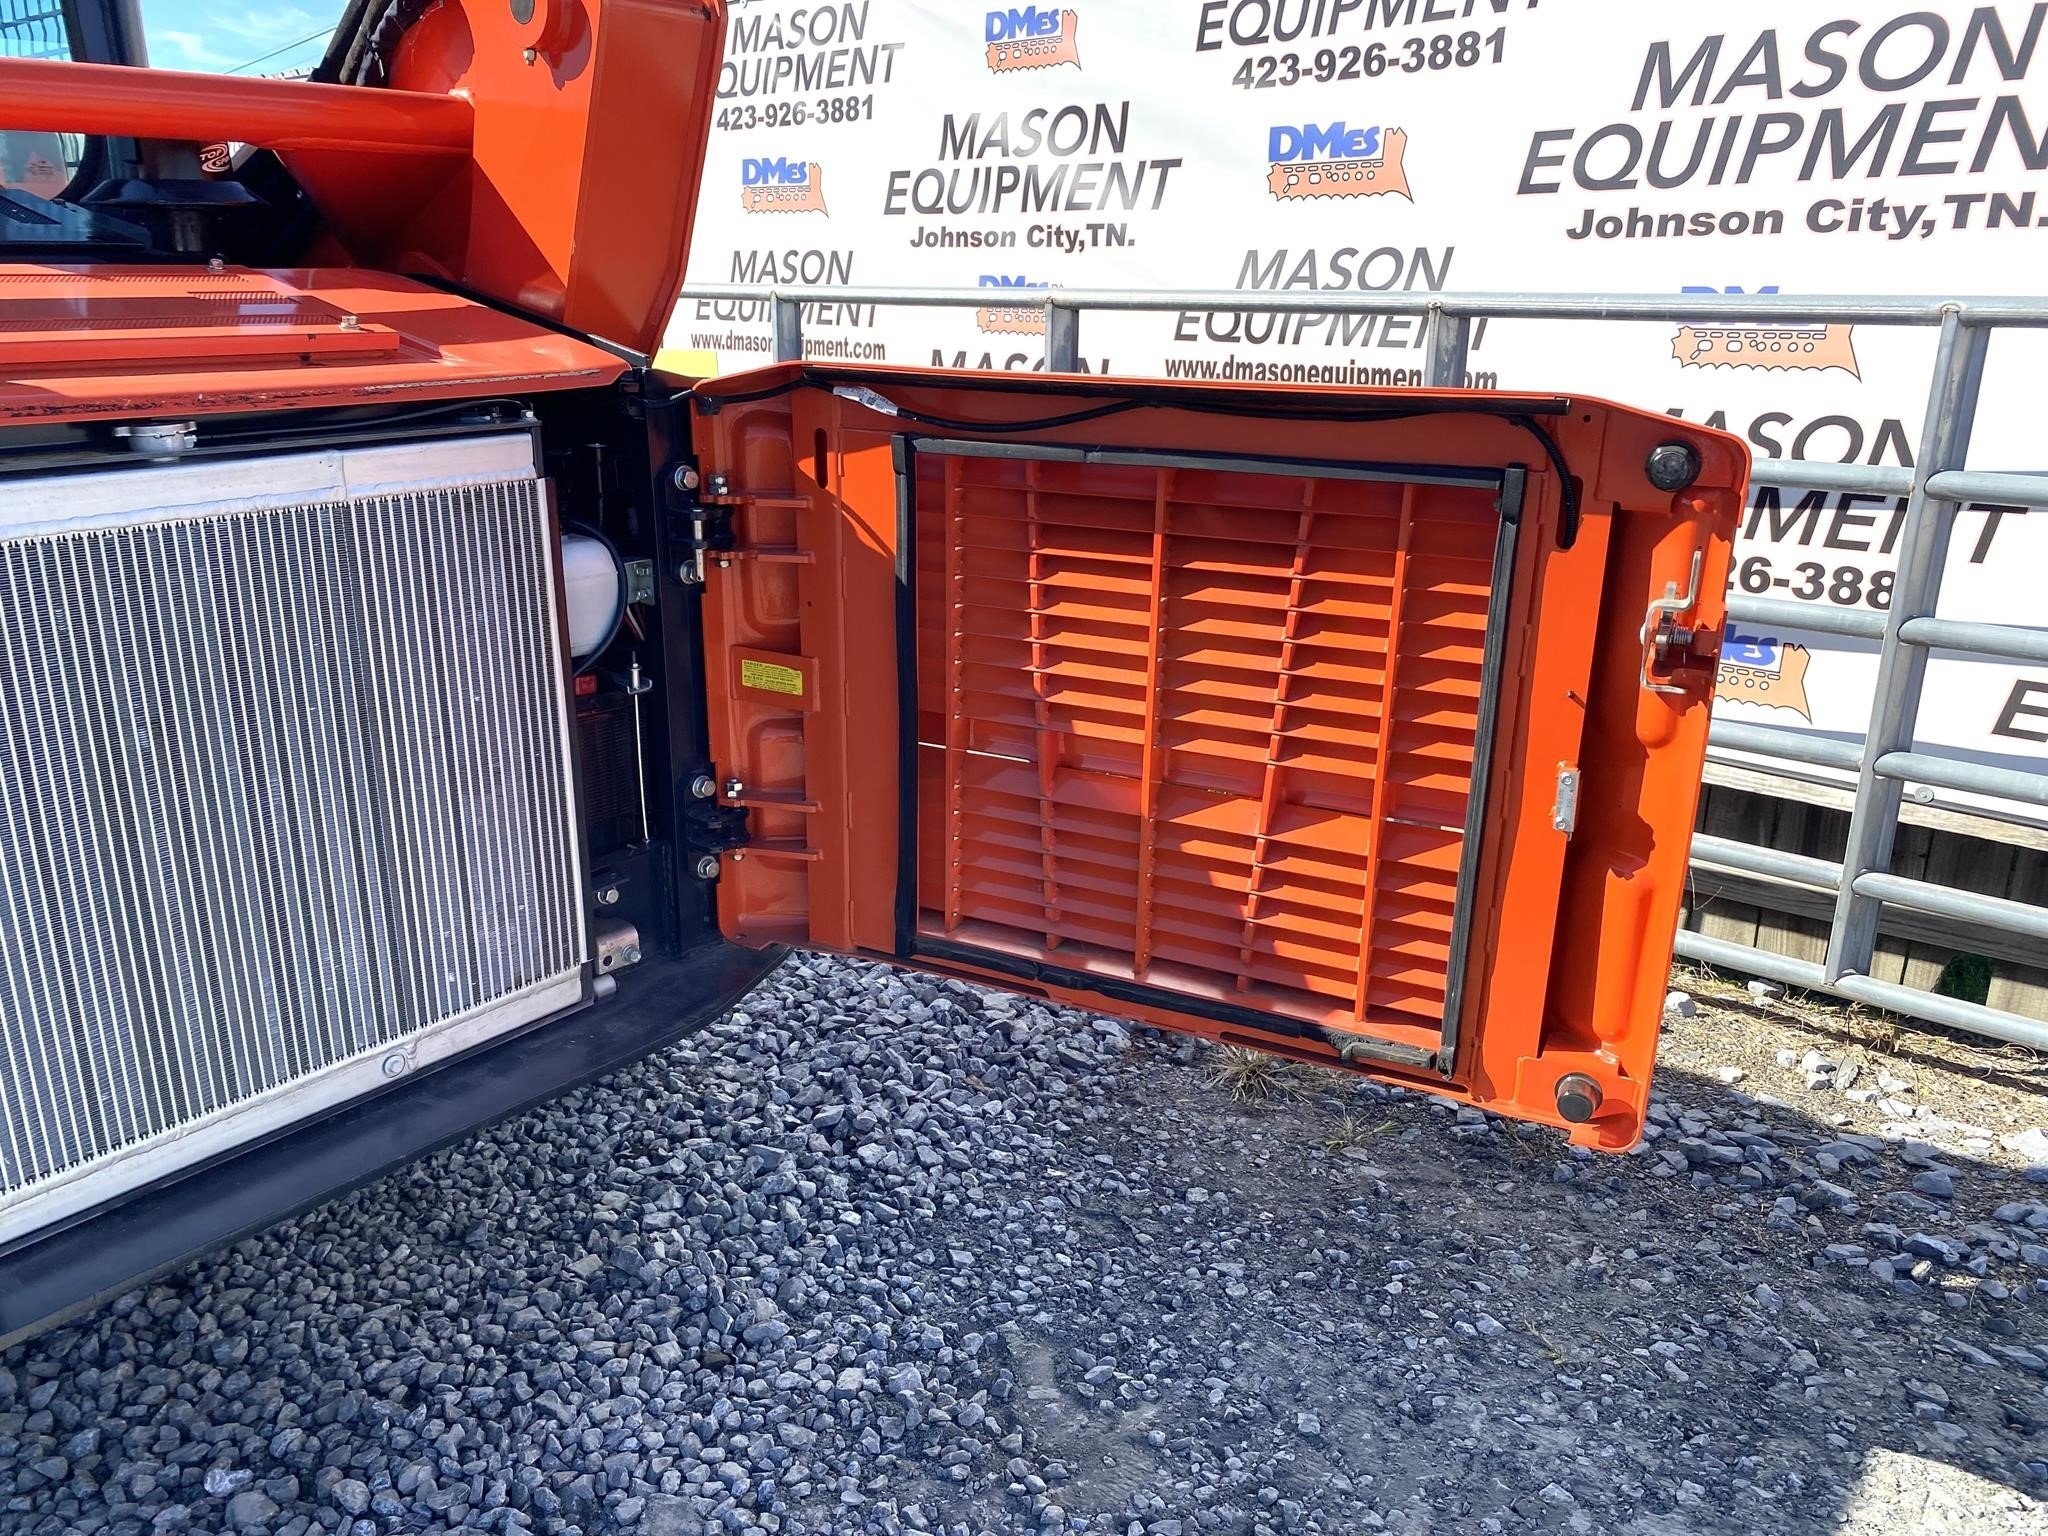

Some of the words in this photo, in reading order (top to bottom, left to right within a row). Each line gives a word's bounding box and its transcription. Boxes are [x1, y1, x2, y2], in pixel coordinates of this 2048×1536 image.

[731, 0, 869, 55] MASON
[1196, 0, 1541, 52] EQUIPM
[715, 42, 905, 99] QUIPMENT
[1232, 26, 1507, 90] 423-926-3881
[1631, 2, 2048, 111] MASON
[716, 94, 873, 131] 423-926-3881
[938, 101, 1130, 161] MASON
[883, 157, 1183, 216] EQUIPMENT
[910, 224, 1016, 249] Johnson
[1026, 222, 1136, 254] City,TN.
[1566, 207, 1783, 240] Johnson
[1806, 191, 2048, 241] City,TN.
[730, 250, 853, 285] MASON
[1235, 246, 1455, 291] MASON
